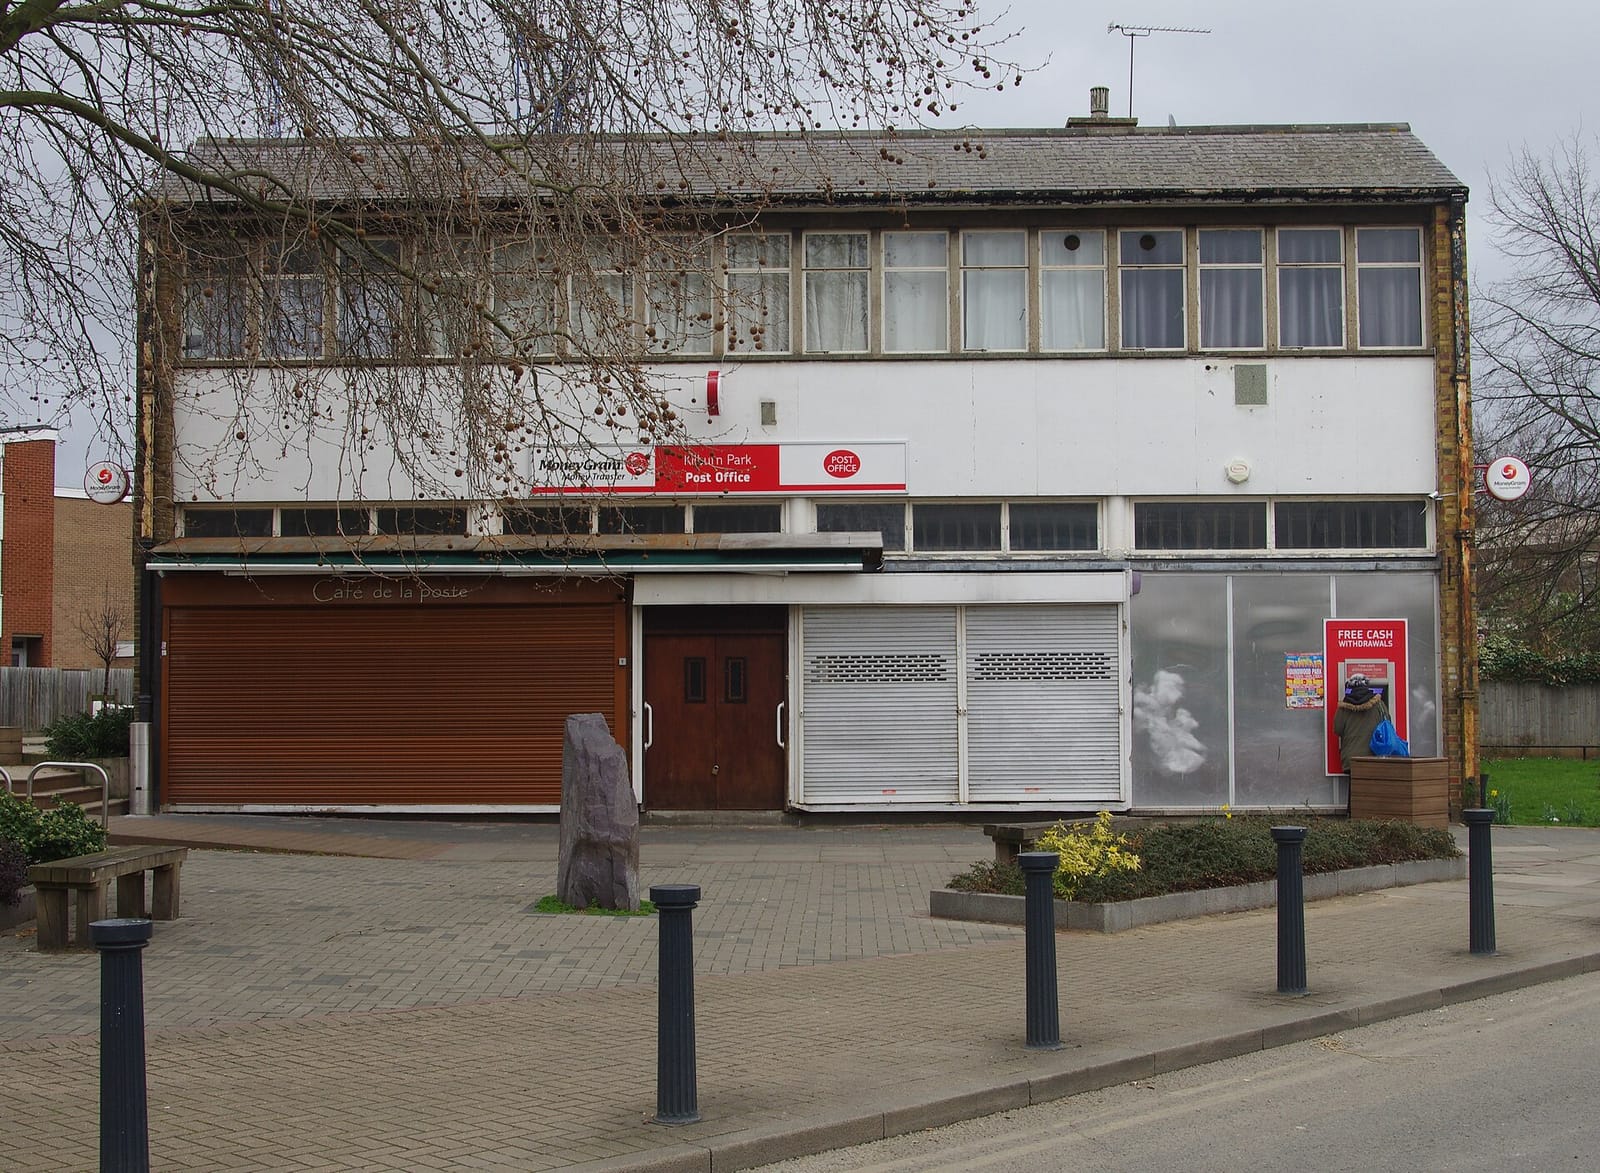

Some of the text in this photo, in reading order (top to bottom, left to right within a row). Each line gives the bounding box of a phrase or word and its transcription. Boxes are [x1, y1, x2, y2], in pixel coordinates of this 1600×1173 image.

[727, 454, 752, 465] Park
[831, 455, 855, 464] POST
[827, 464, 857, 472] OFFICE
[685, 471, 751, 483] Post Office
[313, 578, 468, 603] Café de la poste
[1338, 630, 1393, 639] FREE CASH
